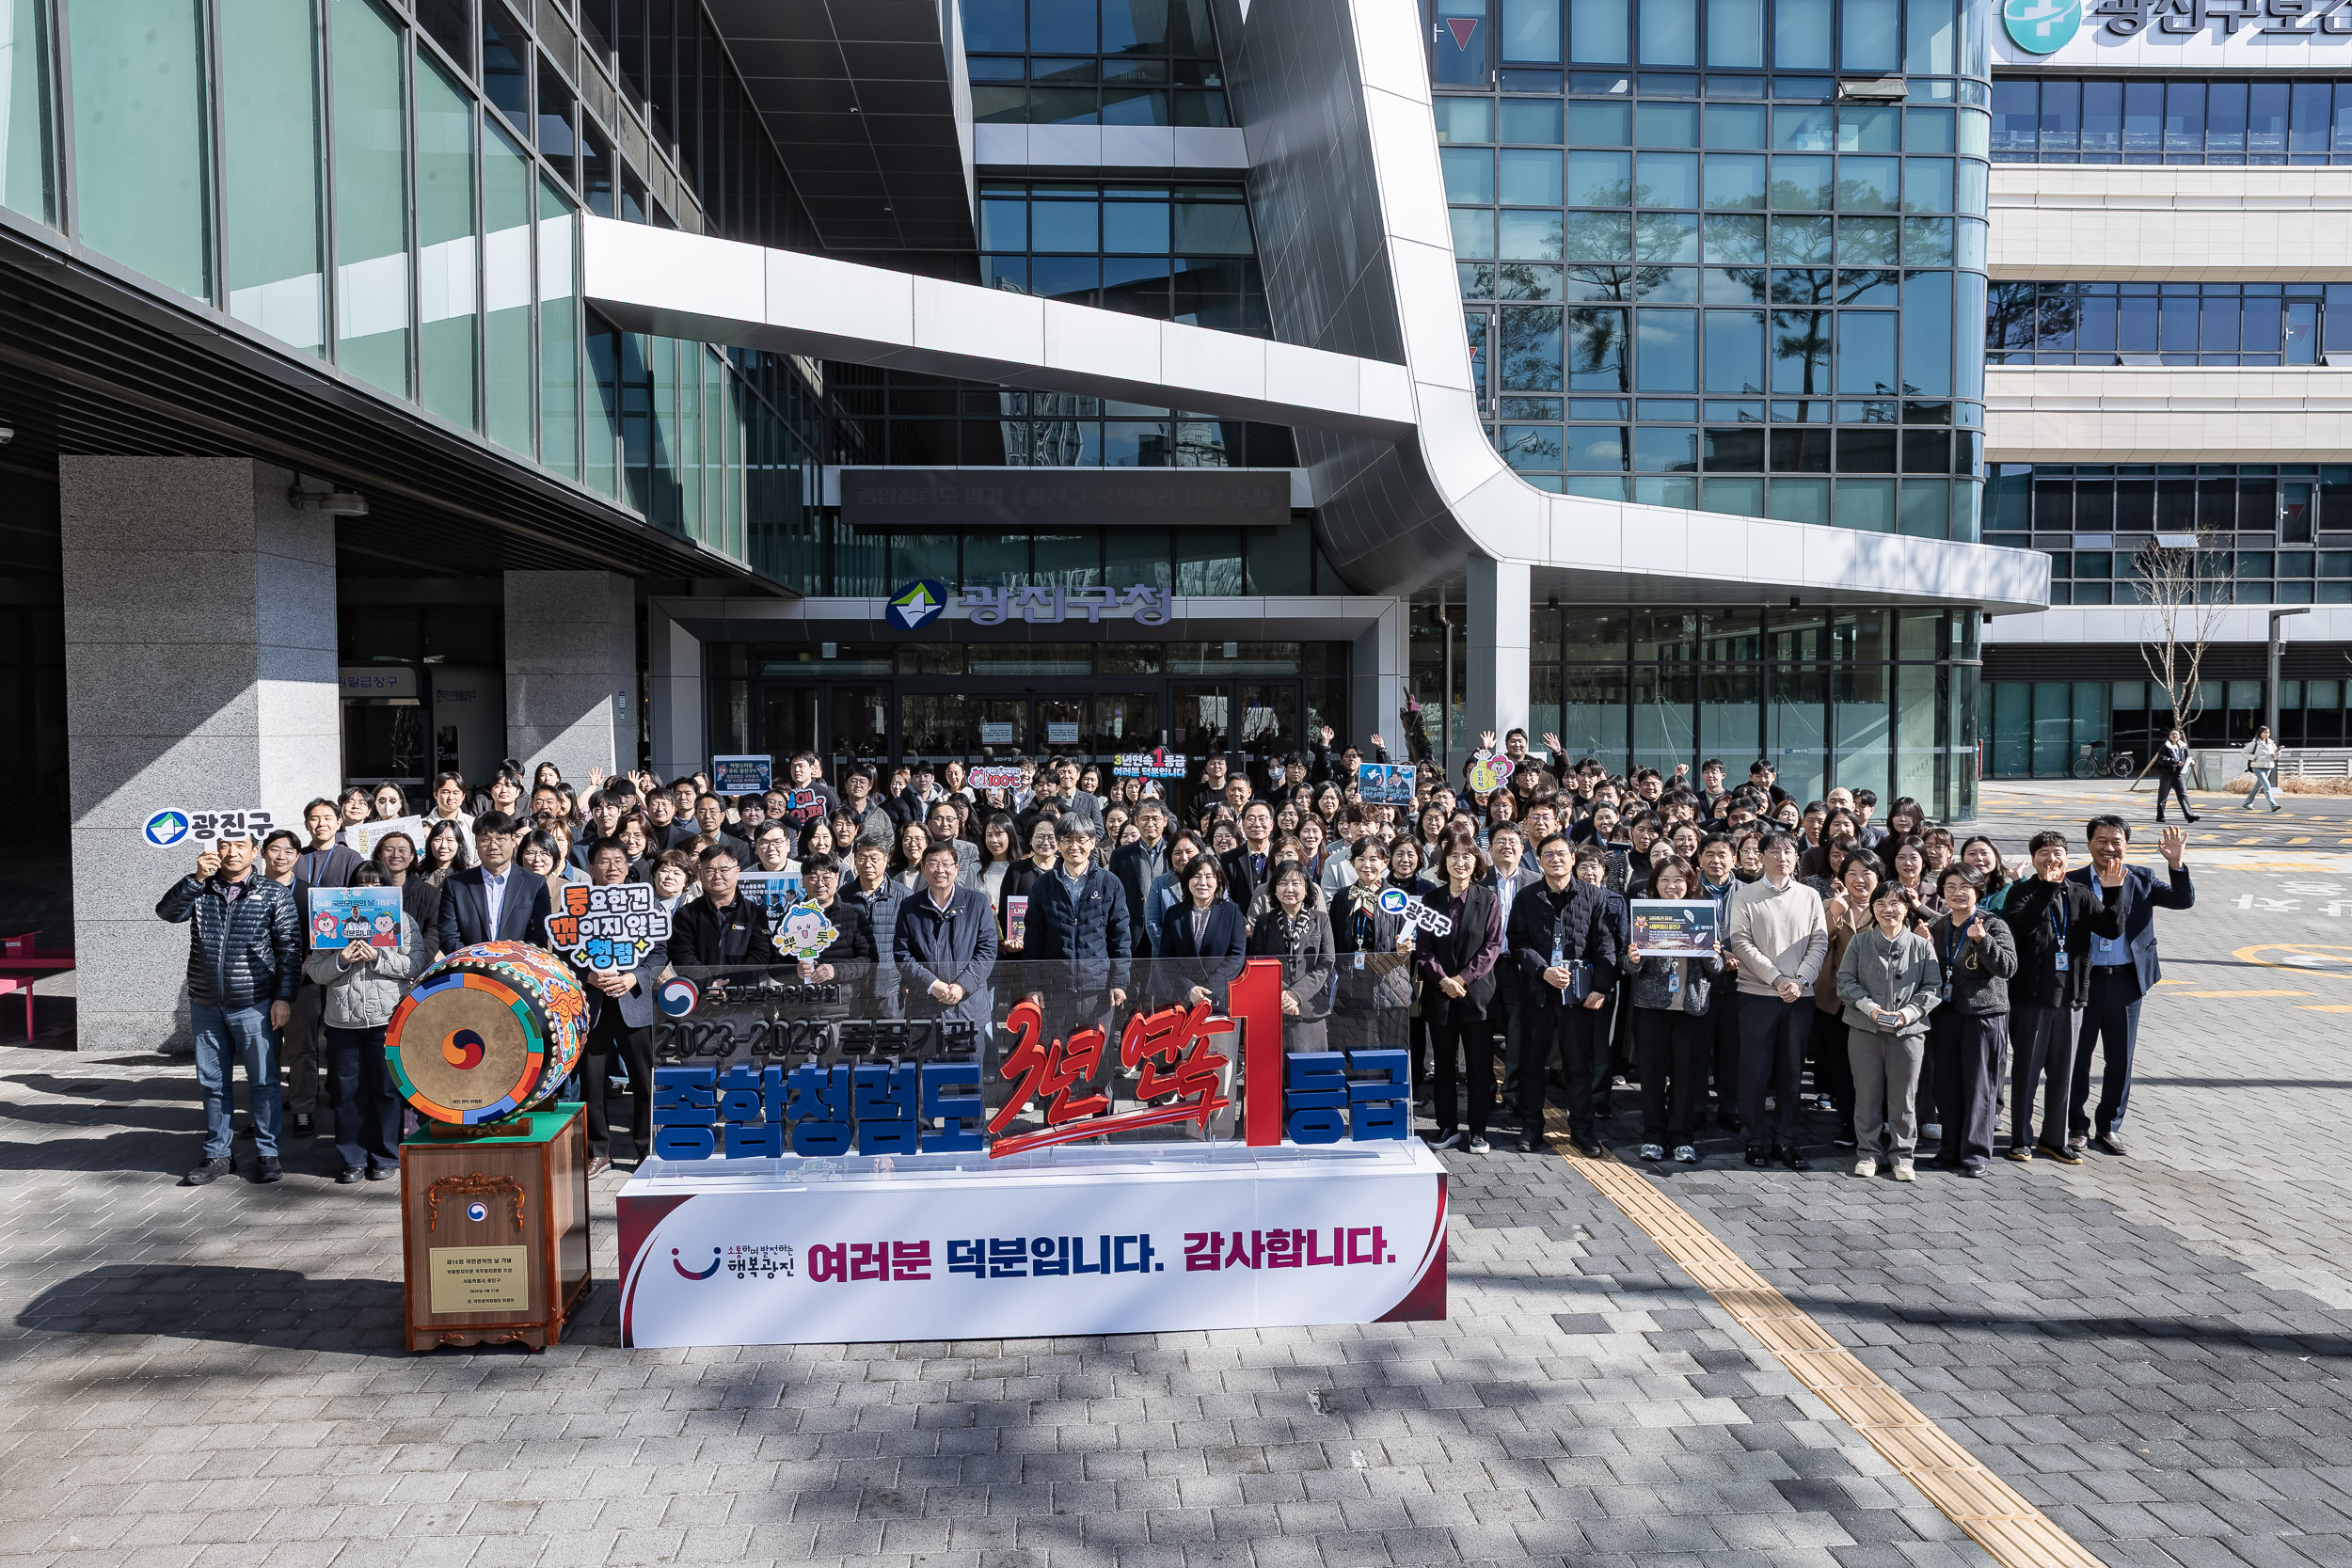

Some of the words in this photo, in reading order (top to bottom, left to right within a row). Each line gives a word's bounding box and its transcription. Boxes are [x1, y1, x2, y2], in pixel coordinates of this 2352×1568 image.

[957, 583, 1172, 626] 광진구청
[1113, 767, 1140, 777] 여러분
[1141, 767, 1186, 778] 덕분입니다
[191, 812, 275, 840] 광진구
[565, 887, 648, 916] 중요한건
[549, 916, 622, 945] 꺾이지
[626, 914, 666, 937] 않는
[1405, 901, 1449, 934] 광진구
[587, 939, 633, 968] 청렴
[656, 1018, 833, 1058] 2023-2025
[839, 1018, 979, 1055] 공공기관
[653, 1063, 984, 1161] 종합청렴도
[989, 998, 1109, 1134] 3년
[1120, 1000, 1237, 1131] 연속
[727, 1244, 759, 1259] 소통하며
[760, 1244, 794, 1259] 발전하는
[808, 1240, 932, 1283] 여러분
[946, 1233, 1165, 1280] 덕분입니다.
[1183, 1226, 1396, 1273] 감사합니다.
[727, 1257, 794, 1279] 행복광진
